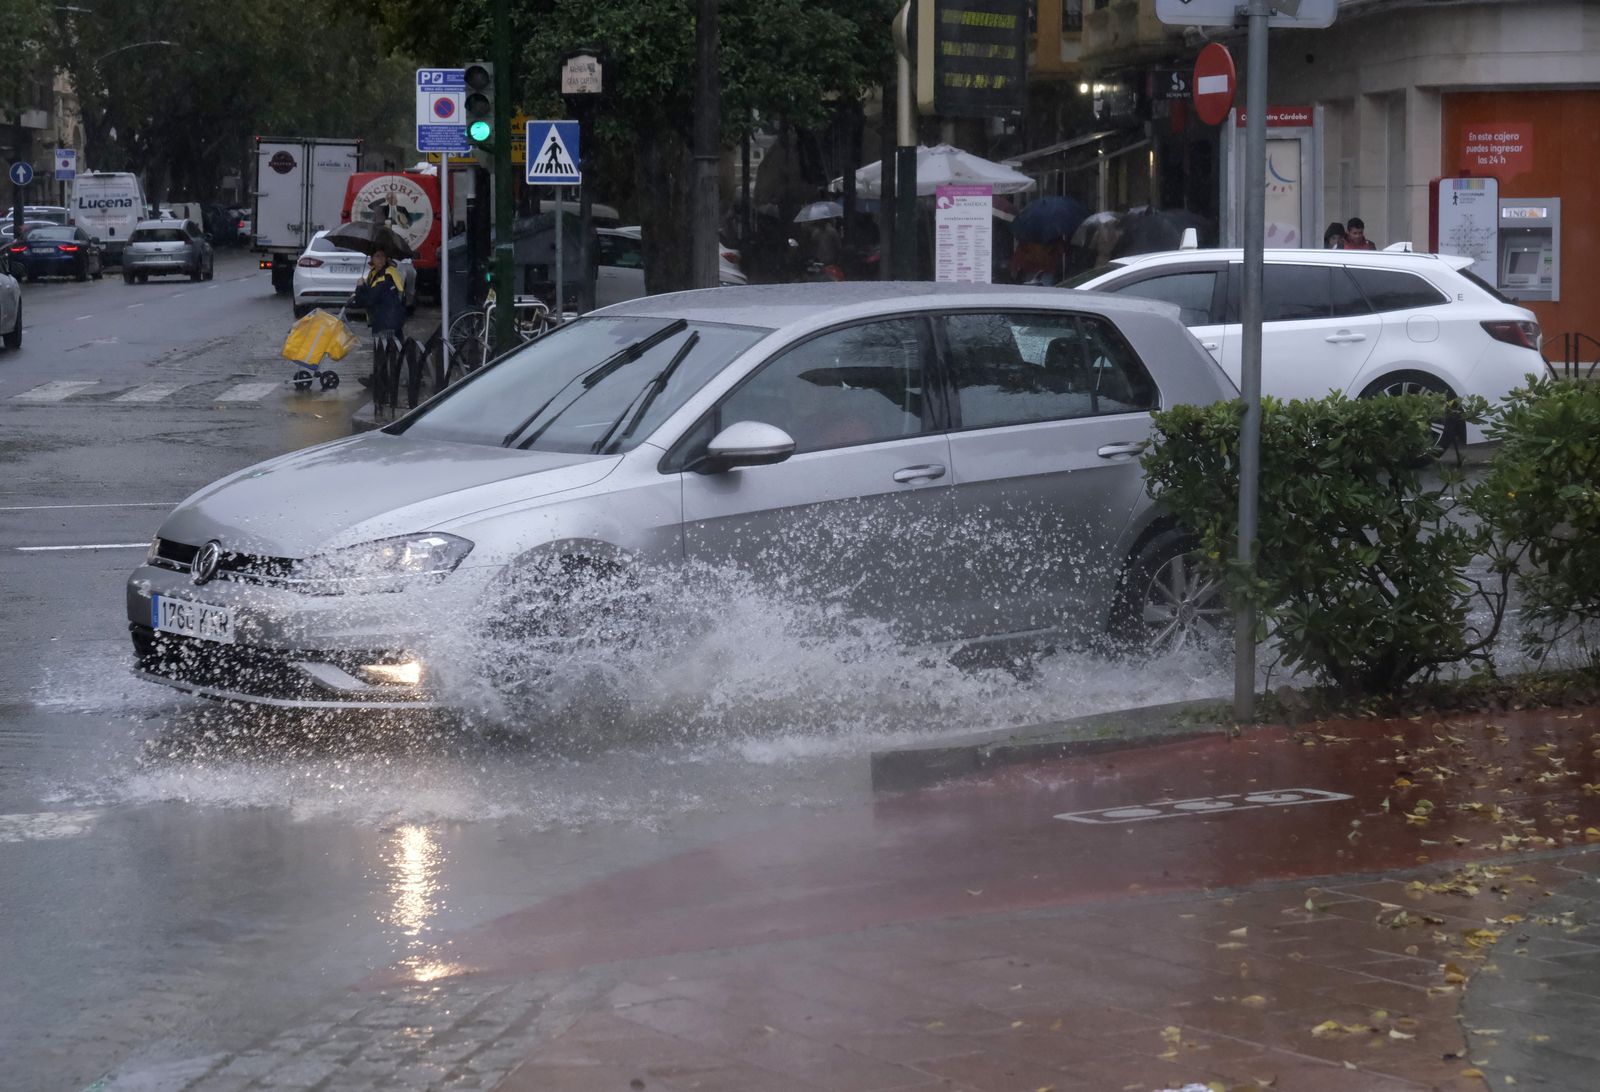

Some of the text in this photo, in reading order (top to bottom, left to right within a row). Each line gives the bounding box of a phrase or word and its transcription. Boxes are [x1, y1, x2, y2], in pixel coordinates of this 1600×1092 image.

[421, 72, 431, 84] P
[1279, 112, 1308, 120] Córdoba
[1469, 132, 1520, 143] En este cajero
[1466, 144, 1523, 155] puedes ingresar
[1478, 155, 1506, 164] las 24 h
[363, 183, 420, 204] VICTORIA
[79, 197, 132, 209] Lucena
[1457, 293, 1464, 301] E
